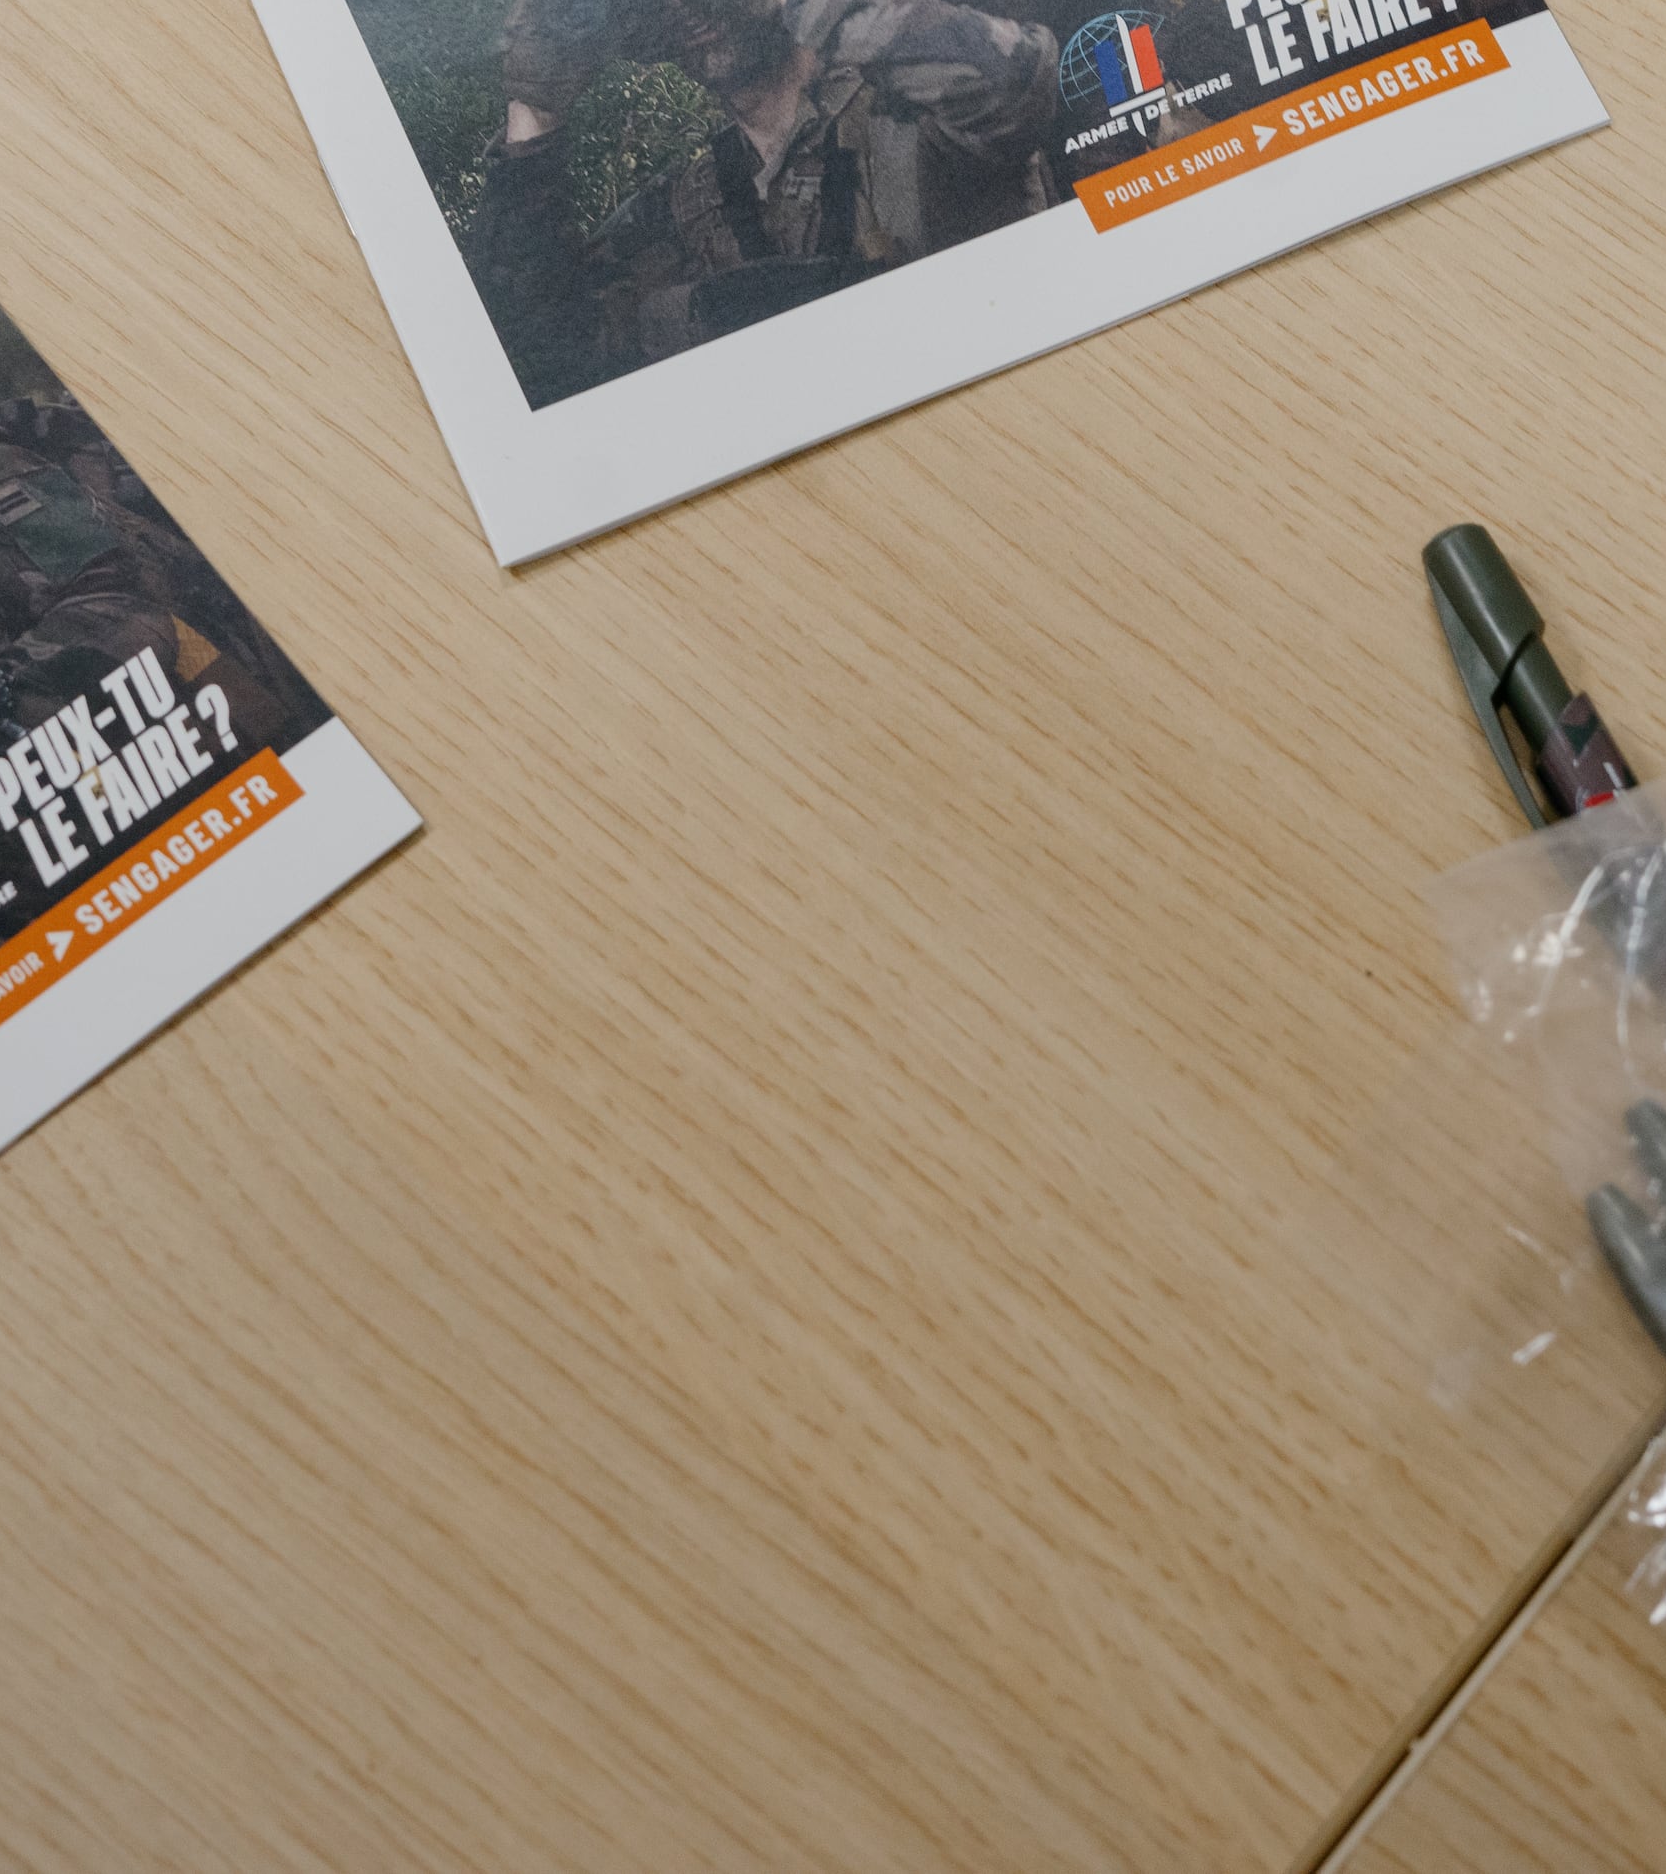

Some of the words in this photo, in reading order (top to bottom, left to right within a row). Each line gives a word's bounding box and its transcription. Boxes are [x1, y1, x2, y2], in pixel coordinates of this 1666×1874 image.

[1244, 8, 1304, 86] LE
[1065, 116, 1129, 155] ARMEE
[1145, 99, 1170, 121] DE
[1172, 72, 1233, 108] TERRE
[1104, 176, 1154, 208] POUR
[1154, 164, 1180, 188] LE
[1182, 137, 1245, 176] SAVOIR
[1281, 36, 1487, 138] SENGAGER.FR
[18, 796, 90, 888] LE
[73, 772, 278, 937] SENGAGER.FR
